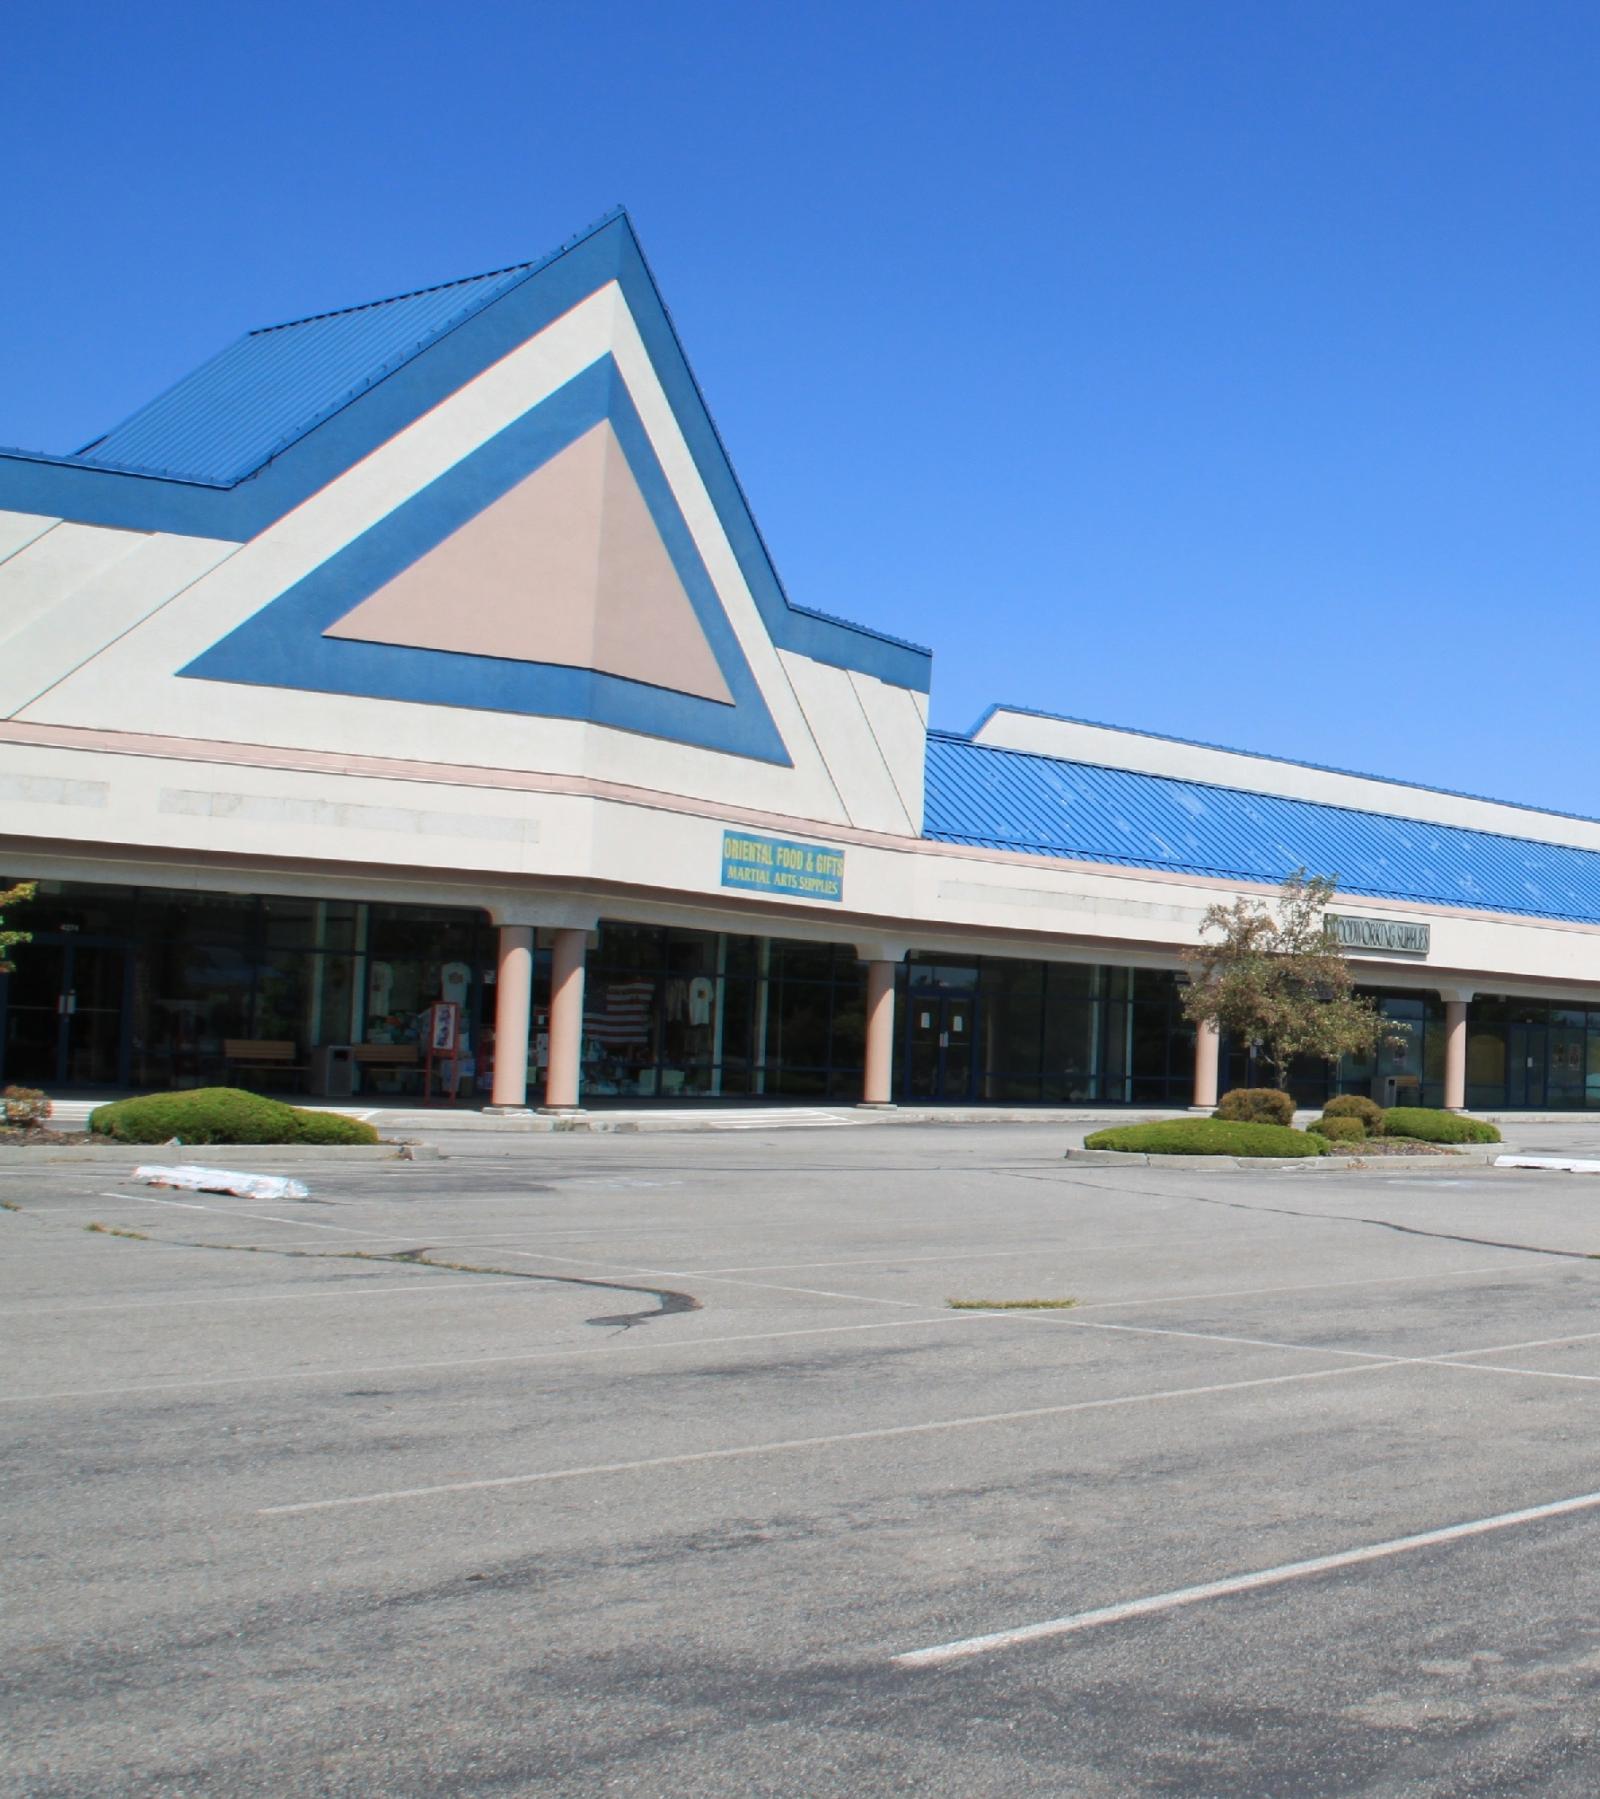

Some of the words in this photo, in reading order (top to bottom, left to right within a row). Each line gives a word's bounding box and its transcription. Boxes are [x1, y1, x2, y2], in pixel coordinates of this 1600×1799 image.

[726, 839, 772, 865] ORIENTAL
[777, 848, 803, 870] FOOD
[807, 853, 814, 872] &
[817, 855, 843, 877] GIFTS
[728, 866, 769, 883] MARTIAL
[775, 873, 798, 887] ARTS
[799, 877, 838, 894] SUPPLIES
